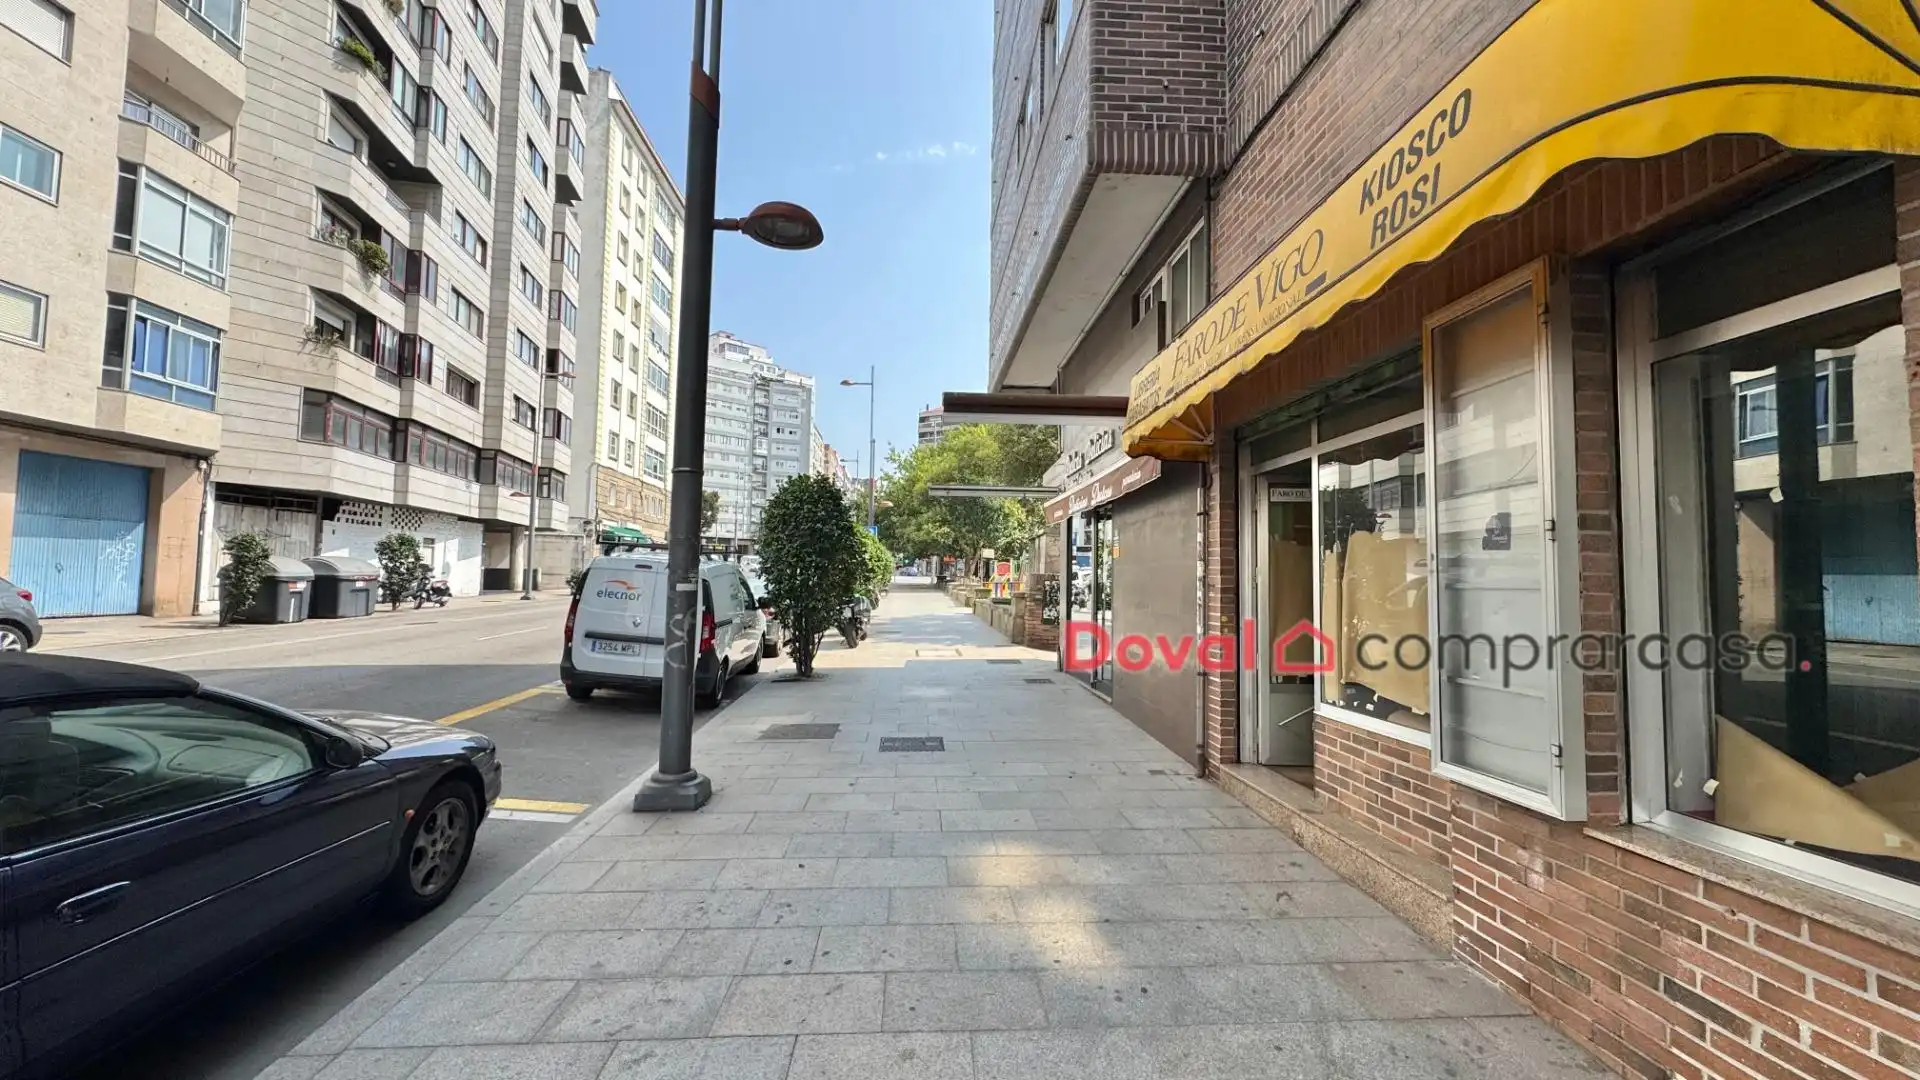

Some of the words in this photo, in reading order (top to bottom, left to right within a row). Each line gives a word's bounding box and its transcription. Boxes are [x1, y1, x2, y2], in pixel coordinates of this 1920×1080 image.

[1359, 88, 1472, 215] KIOSCO
[1370, 162, 1441, 249] ROSI
[1171, 320, 1218, 381] FARO
[1217, 292, 1249, 346] DE
[1255, 229, 1324, 312] VIGO
[596, 587, 642, 601] elecnor
